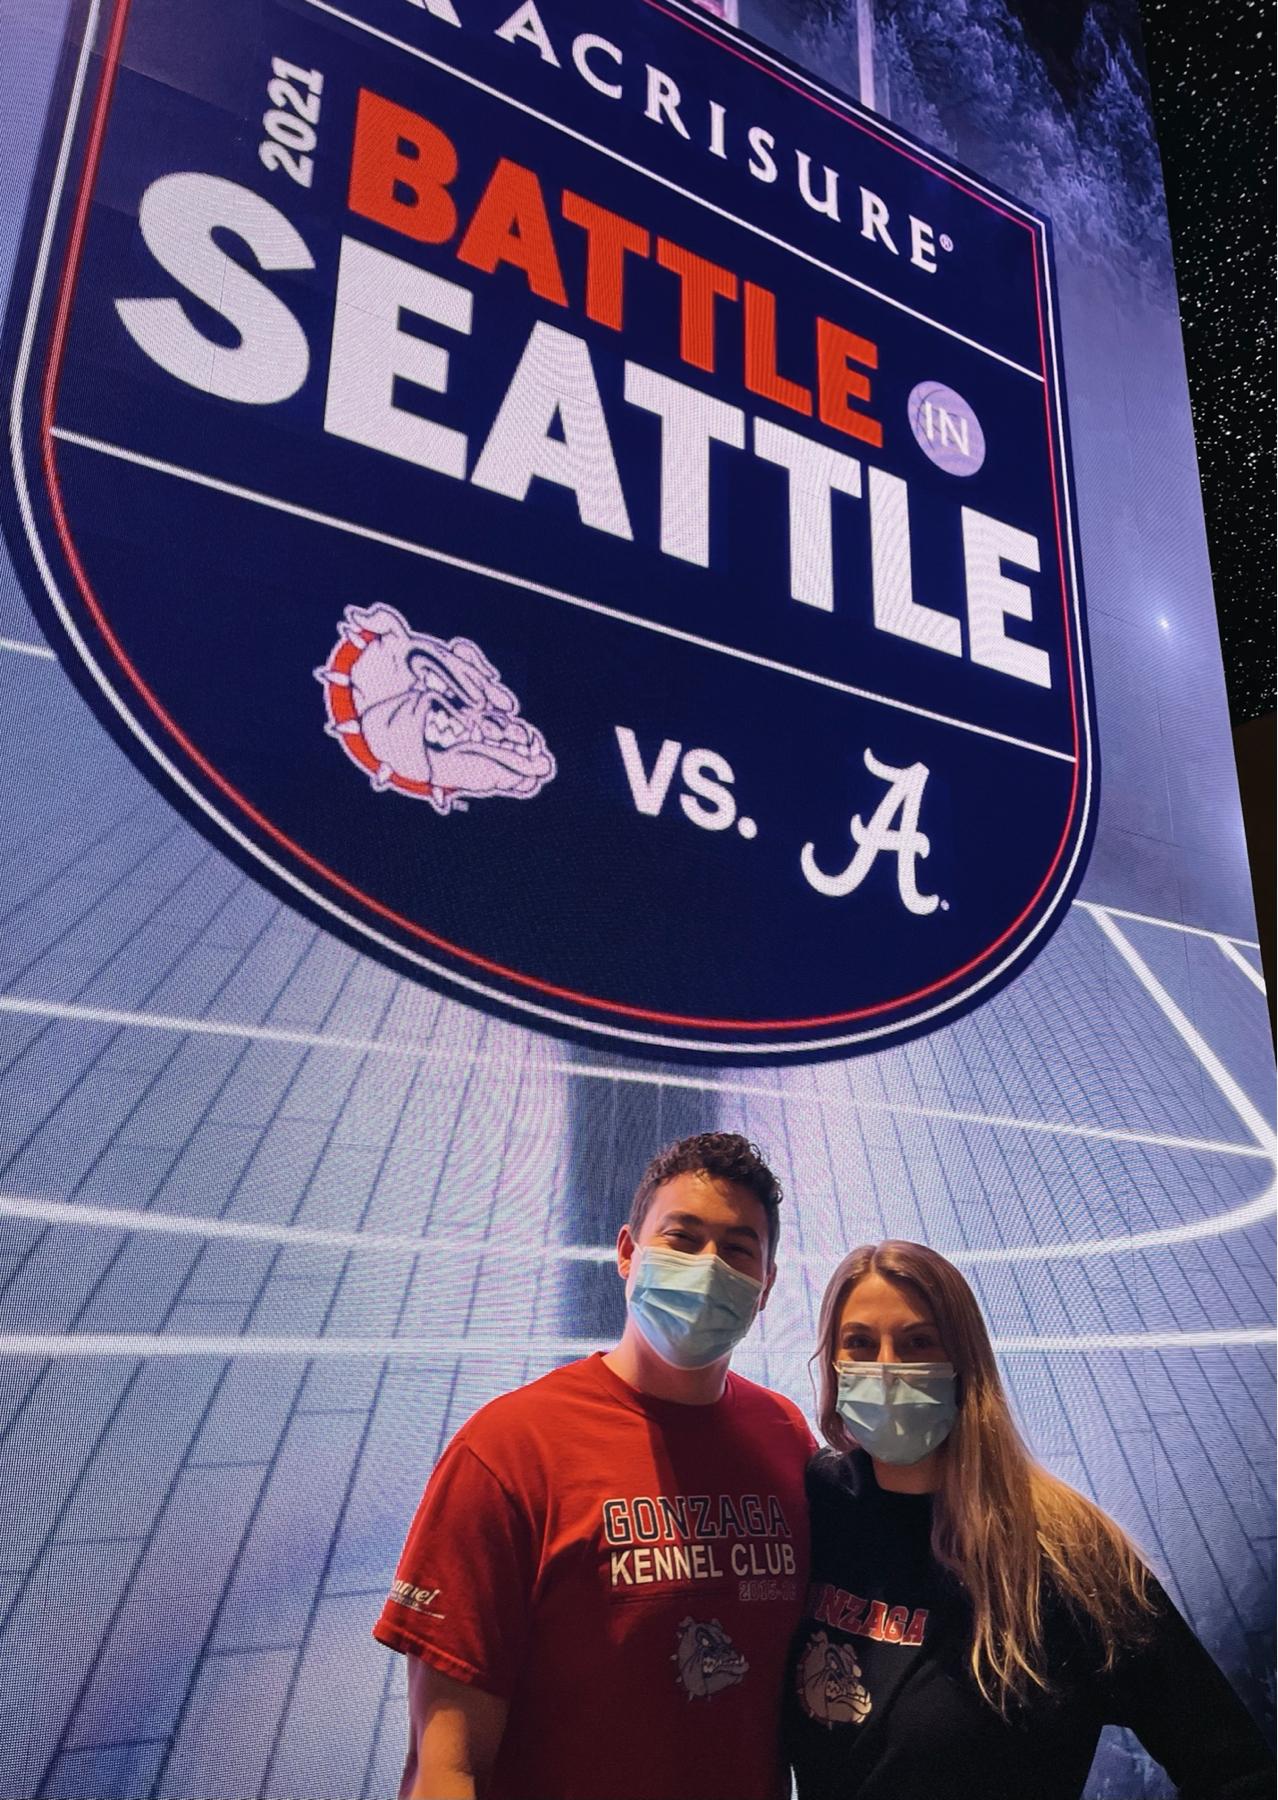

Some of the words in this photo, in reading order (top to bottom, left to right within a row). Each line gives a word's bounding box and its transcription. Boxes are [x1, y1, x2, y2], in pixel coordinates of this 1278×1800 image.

[258, 56, 325, 188] 2021
[347, 86, 885, 449] BATTLE
[114, 170, 1053, 690] SEATTLE
[922, 399, 972, 457] IN
[602, 1493, 794, 1546] GONZAGA
[610, 1545, 725, 1587] KENNEL
[730, 1542, 797, 1577] CLUB
[808, 1583, 930, 1647] NZAGA
